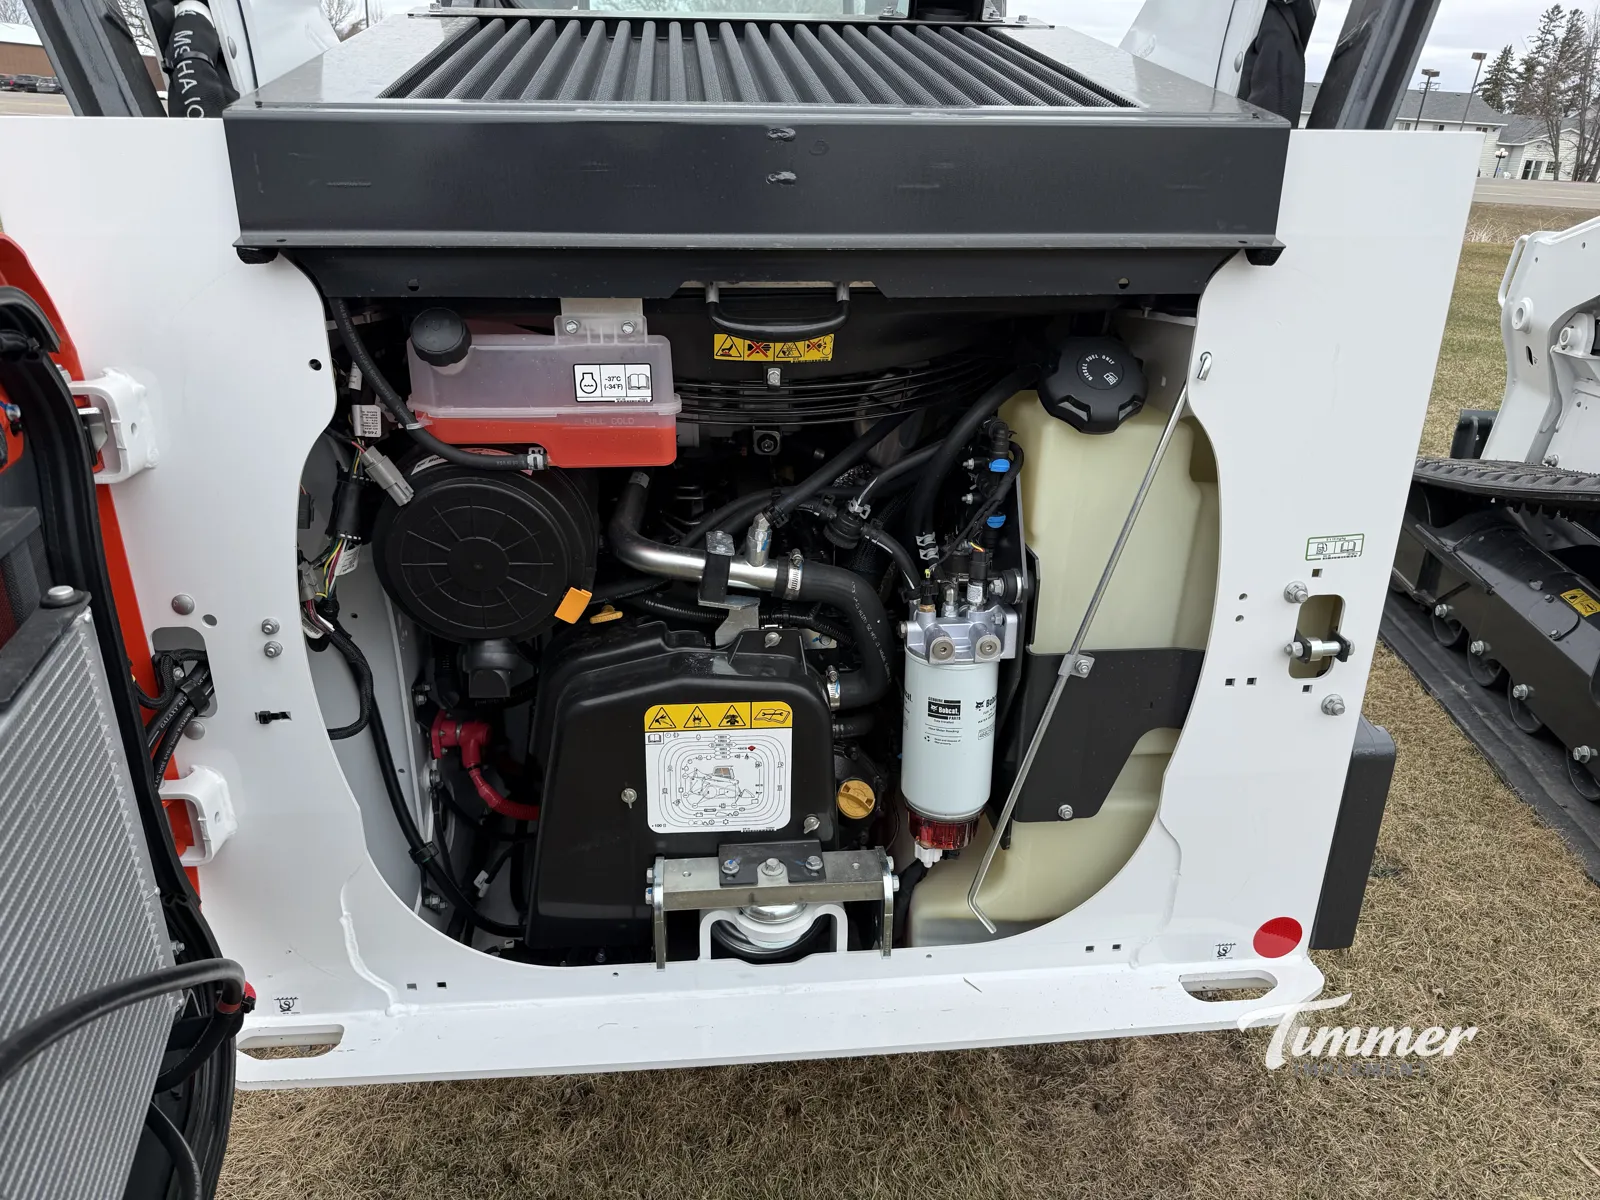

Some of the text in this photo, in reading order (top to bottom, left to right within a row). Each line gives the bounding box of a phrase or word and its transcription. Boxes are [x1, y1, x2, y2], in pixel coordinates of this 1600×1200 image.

[1101, 354, 1115, 365] ONLY
[611, 417, 634, 425] COLD
[160, 705, 179, 729] GALAXY
